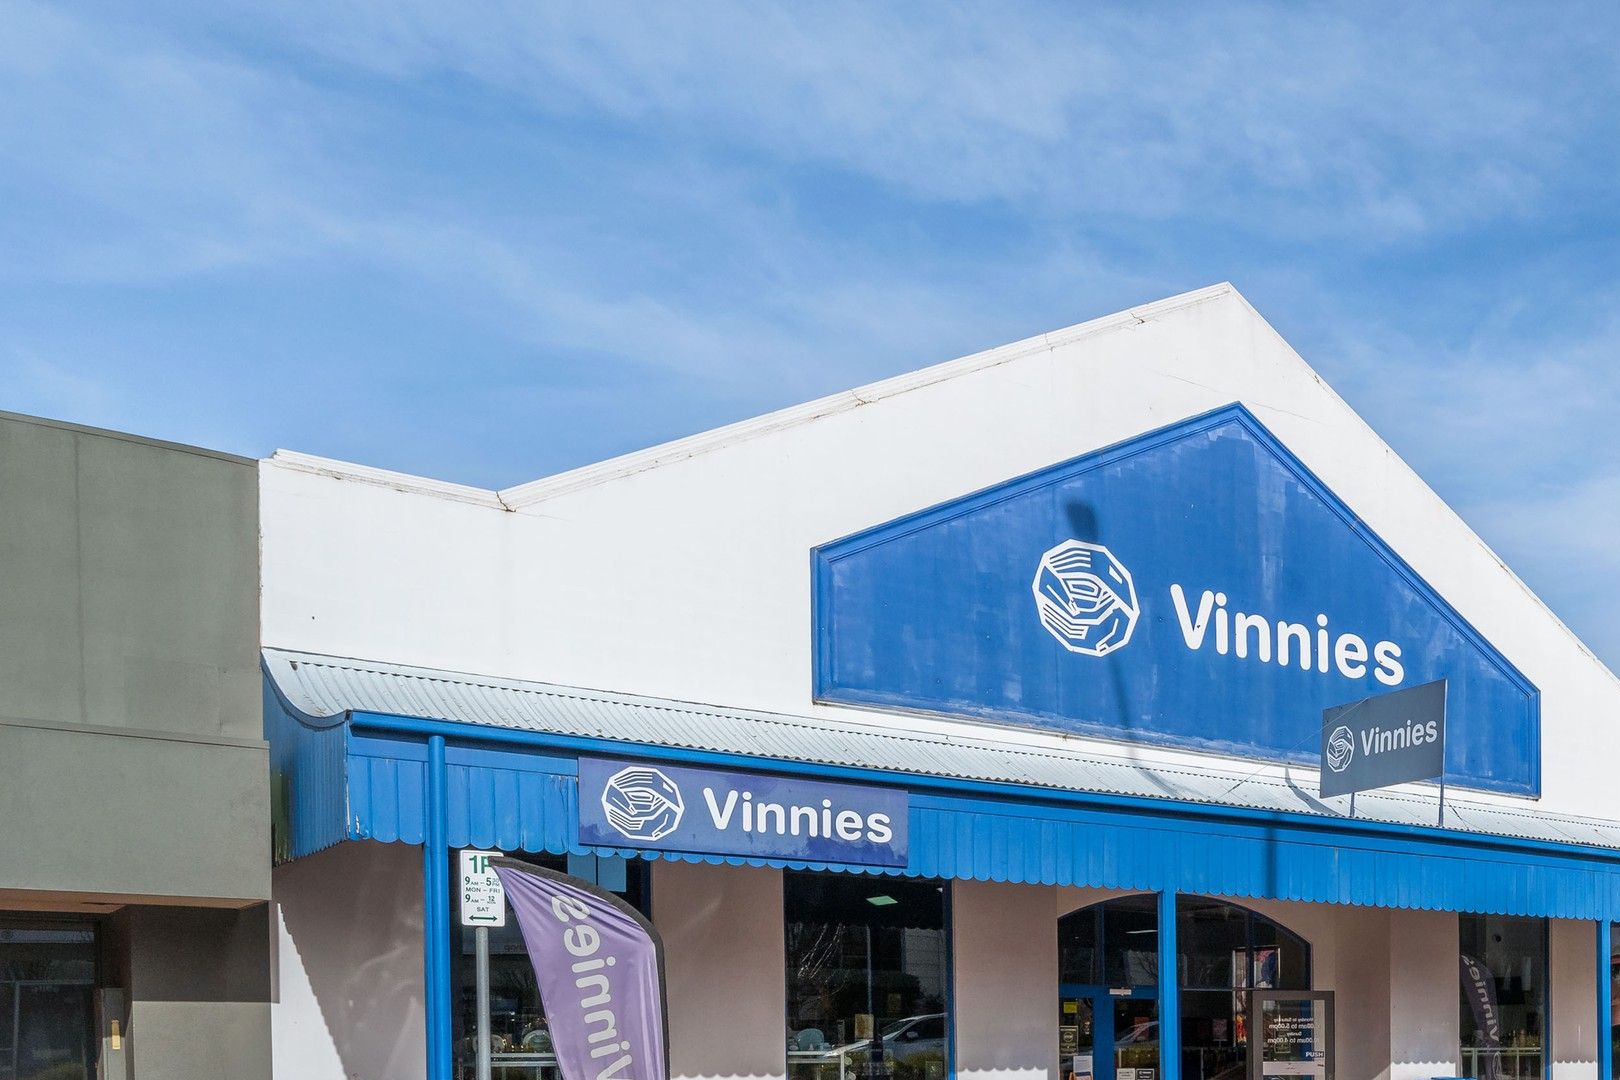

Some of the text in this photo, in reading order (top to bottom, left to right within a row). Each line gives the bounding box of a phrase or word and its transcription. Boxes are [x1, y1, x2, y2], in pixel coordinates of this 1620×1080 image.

[1170, 583, 1405, 686] Vinnies
[1361, 719, 1438, 757] Vinnies
[702, 786, 893, 844] Vinnies
